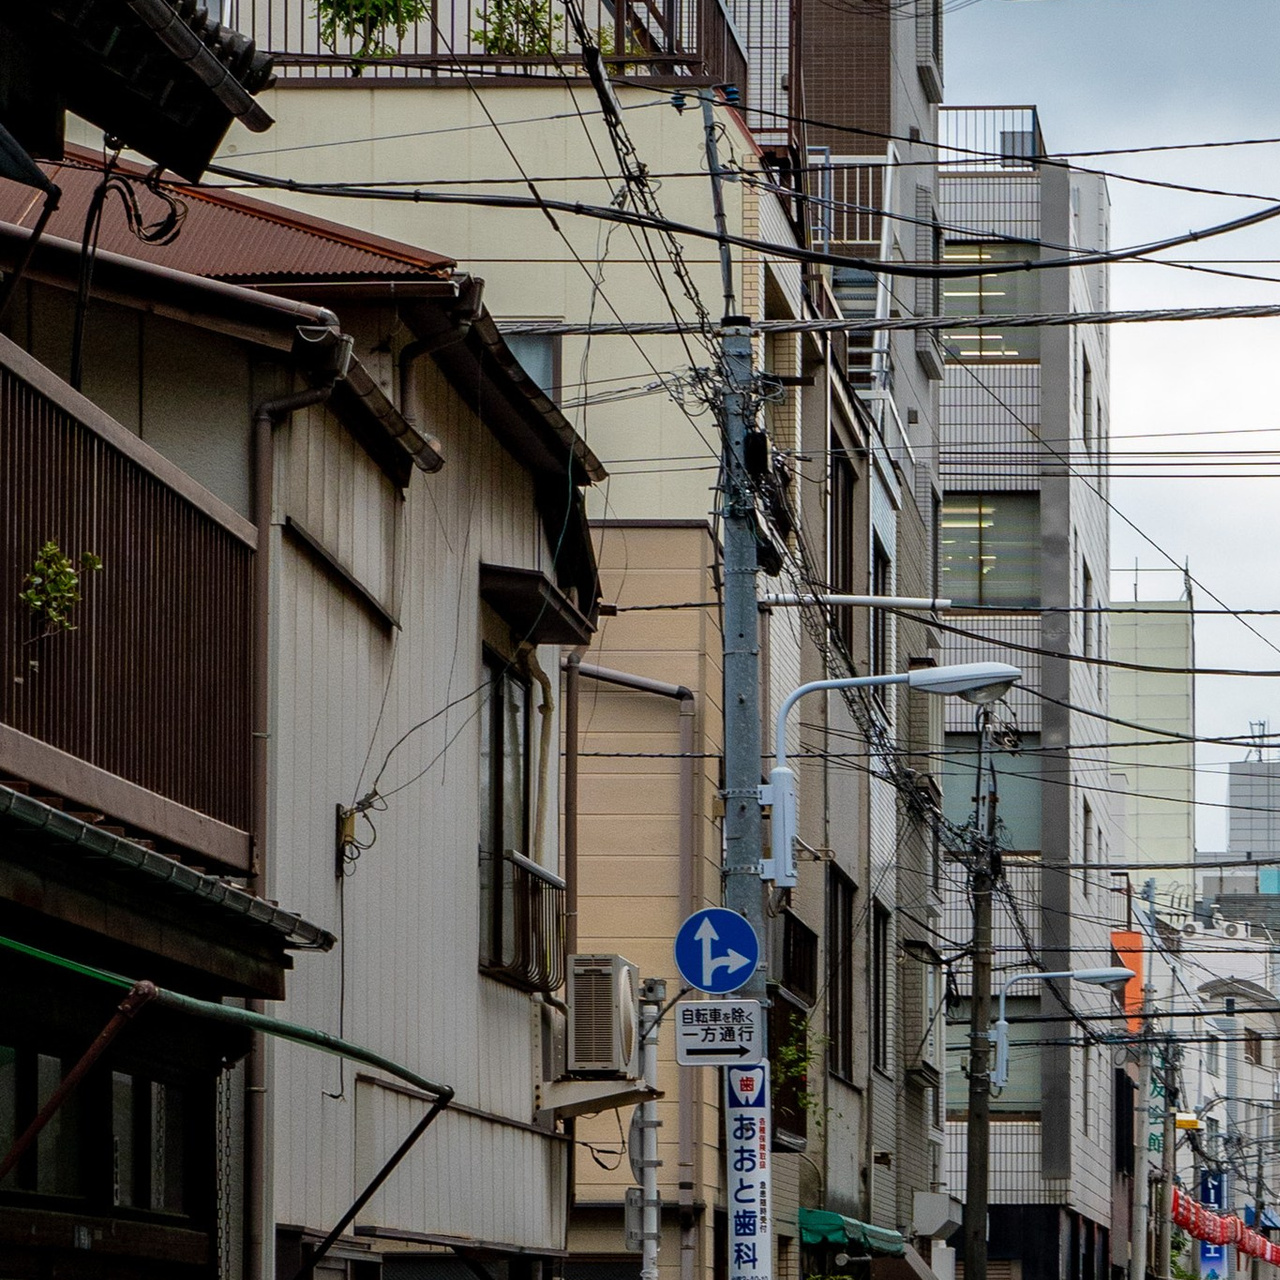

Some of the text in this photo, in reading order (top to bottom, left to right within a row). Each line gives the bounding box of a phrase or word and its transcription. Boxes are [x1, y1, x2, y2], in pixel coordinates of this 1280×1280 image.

[682, 1007, 754, 1023] 自転車を除く
[682, 1026, 754, 1043] 一方通行
[739, 1076, 755, 1092] 歯
[733, 1113, 758, 1270] おおと歯科
